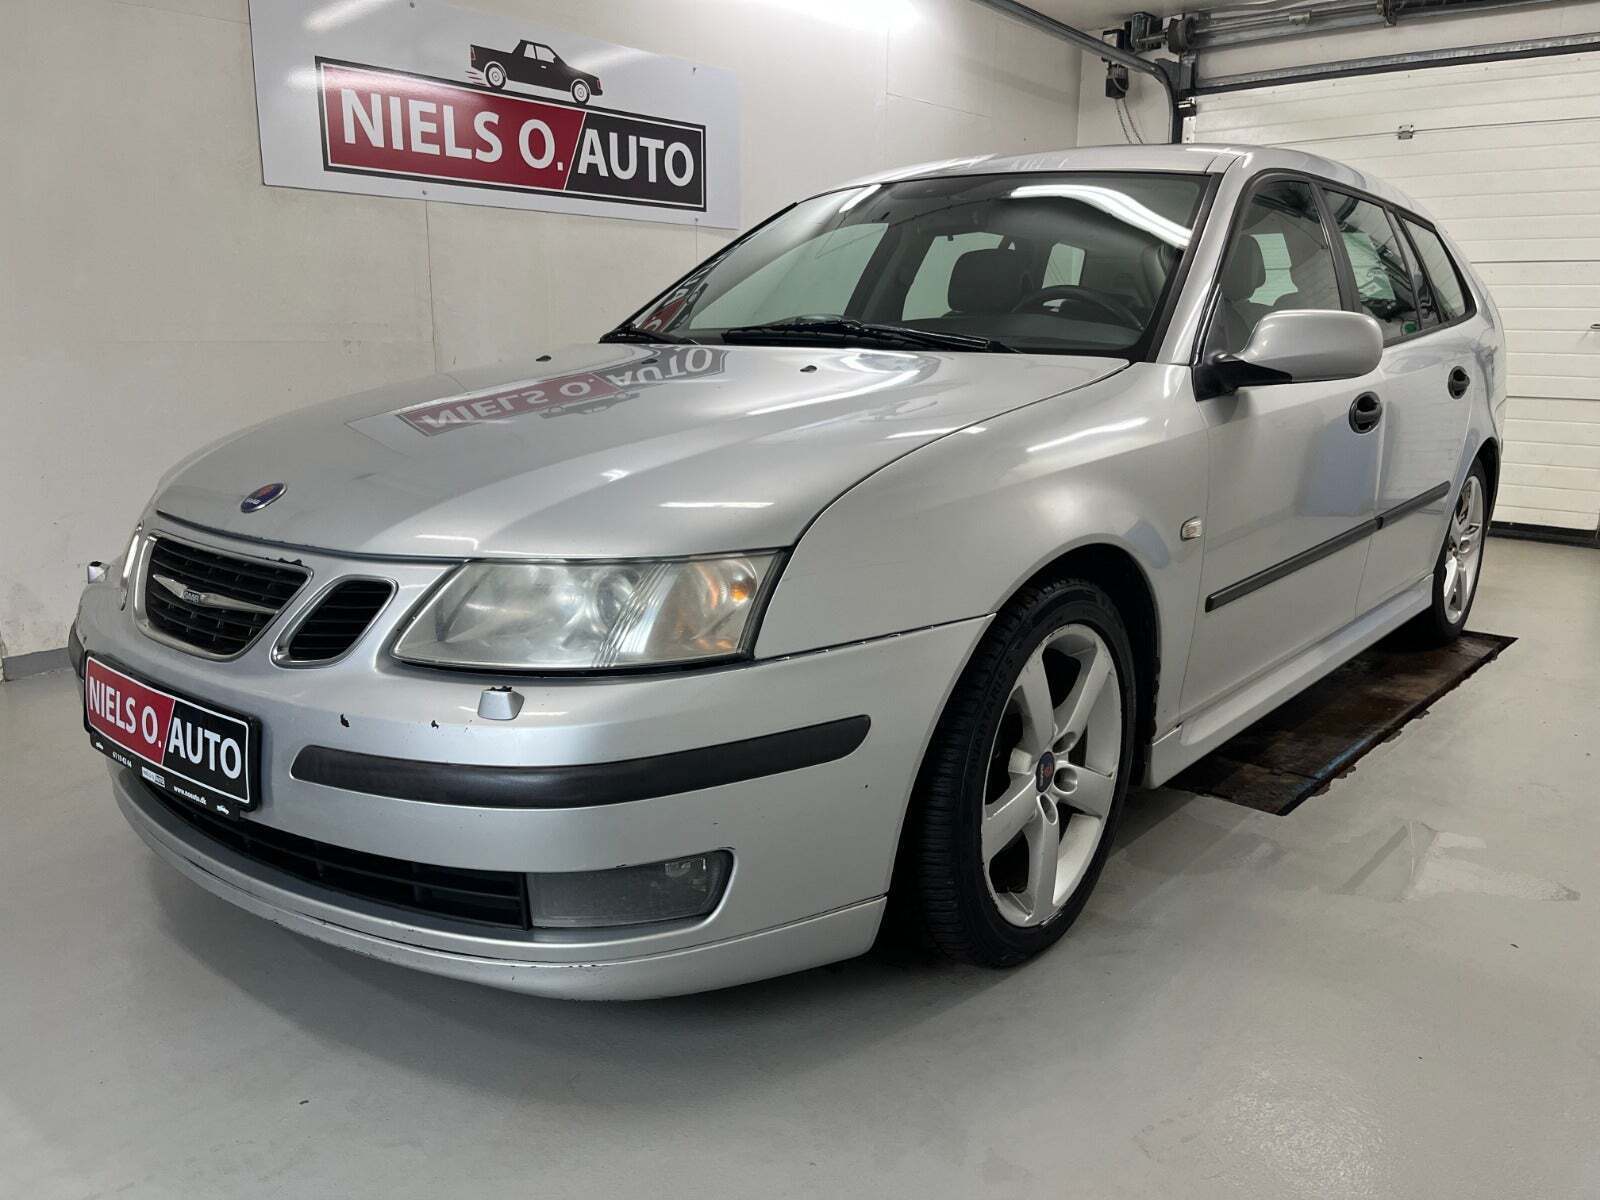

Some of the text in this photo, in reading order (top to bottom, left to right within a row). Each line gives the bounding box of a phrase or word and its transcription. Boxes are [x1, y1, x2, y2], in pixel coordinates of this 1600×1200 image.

[340, 89, 695, 187] NIELS O. AUTO
[88, 676, 242, 780] NIELS O. AUTO
